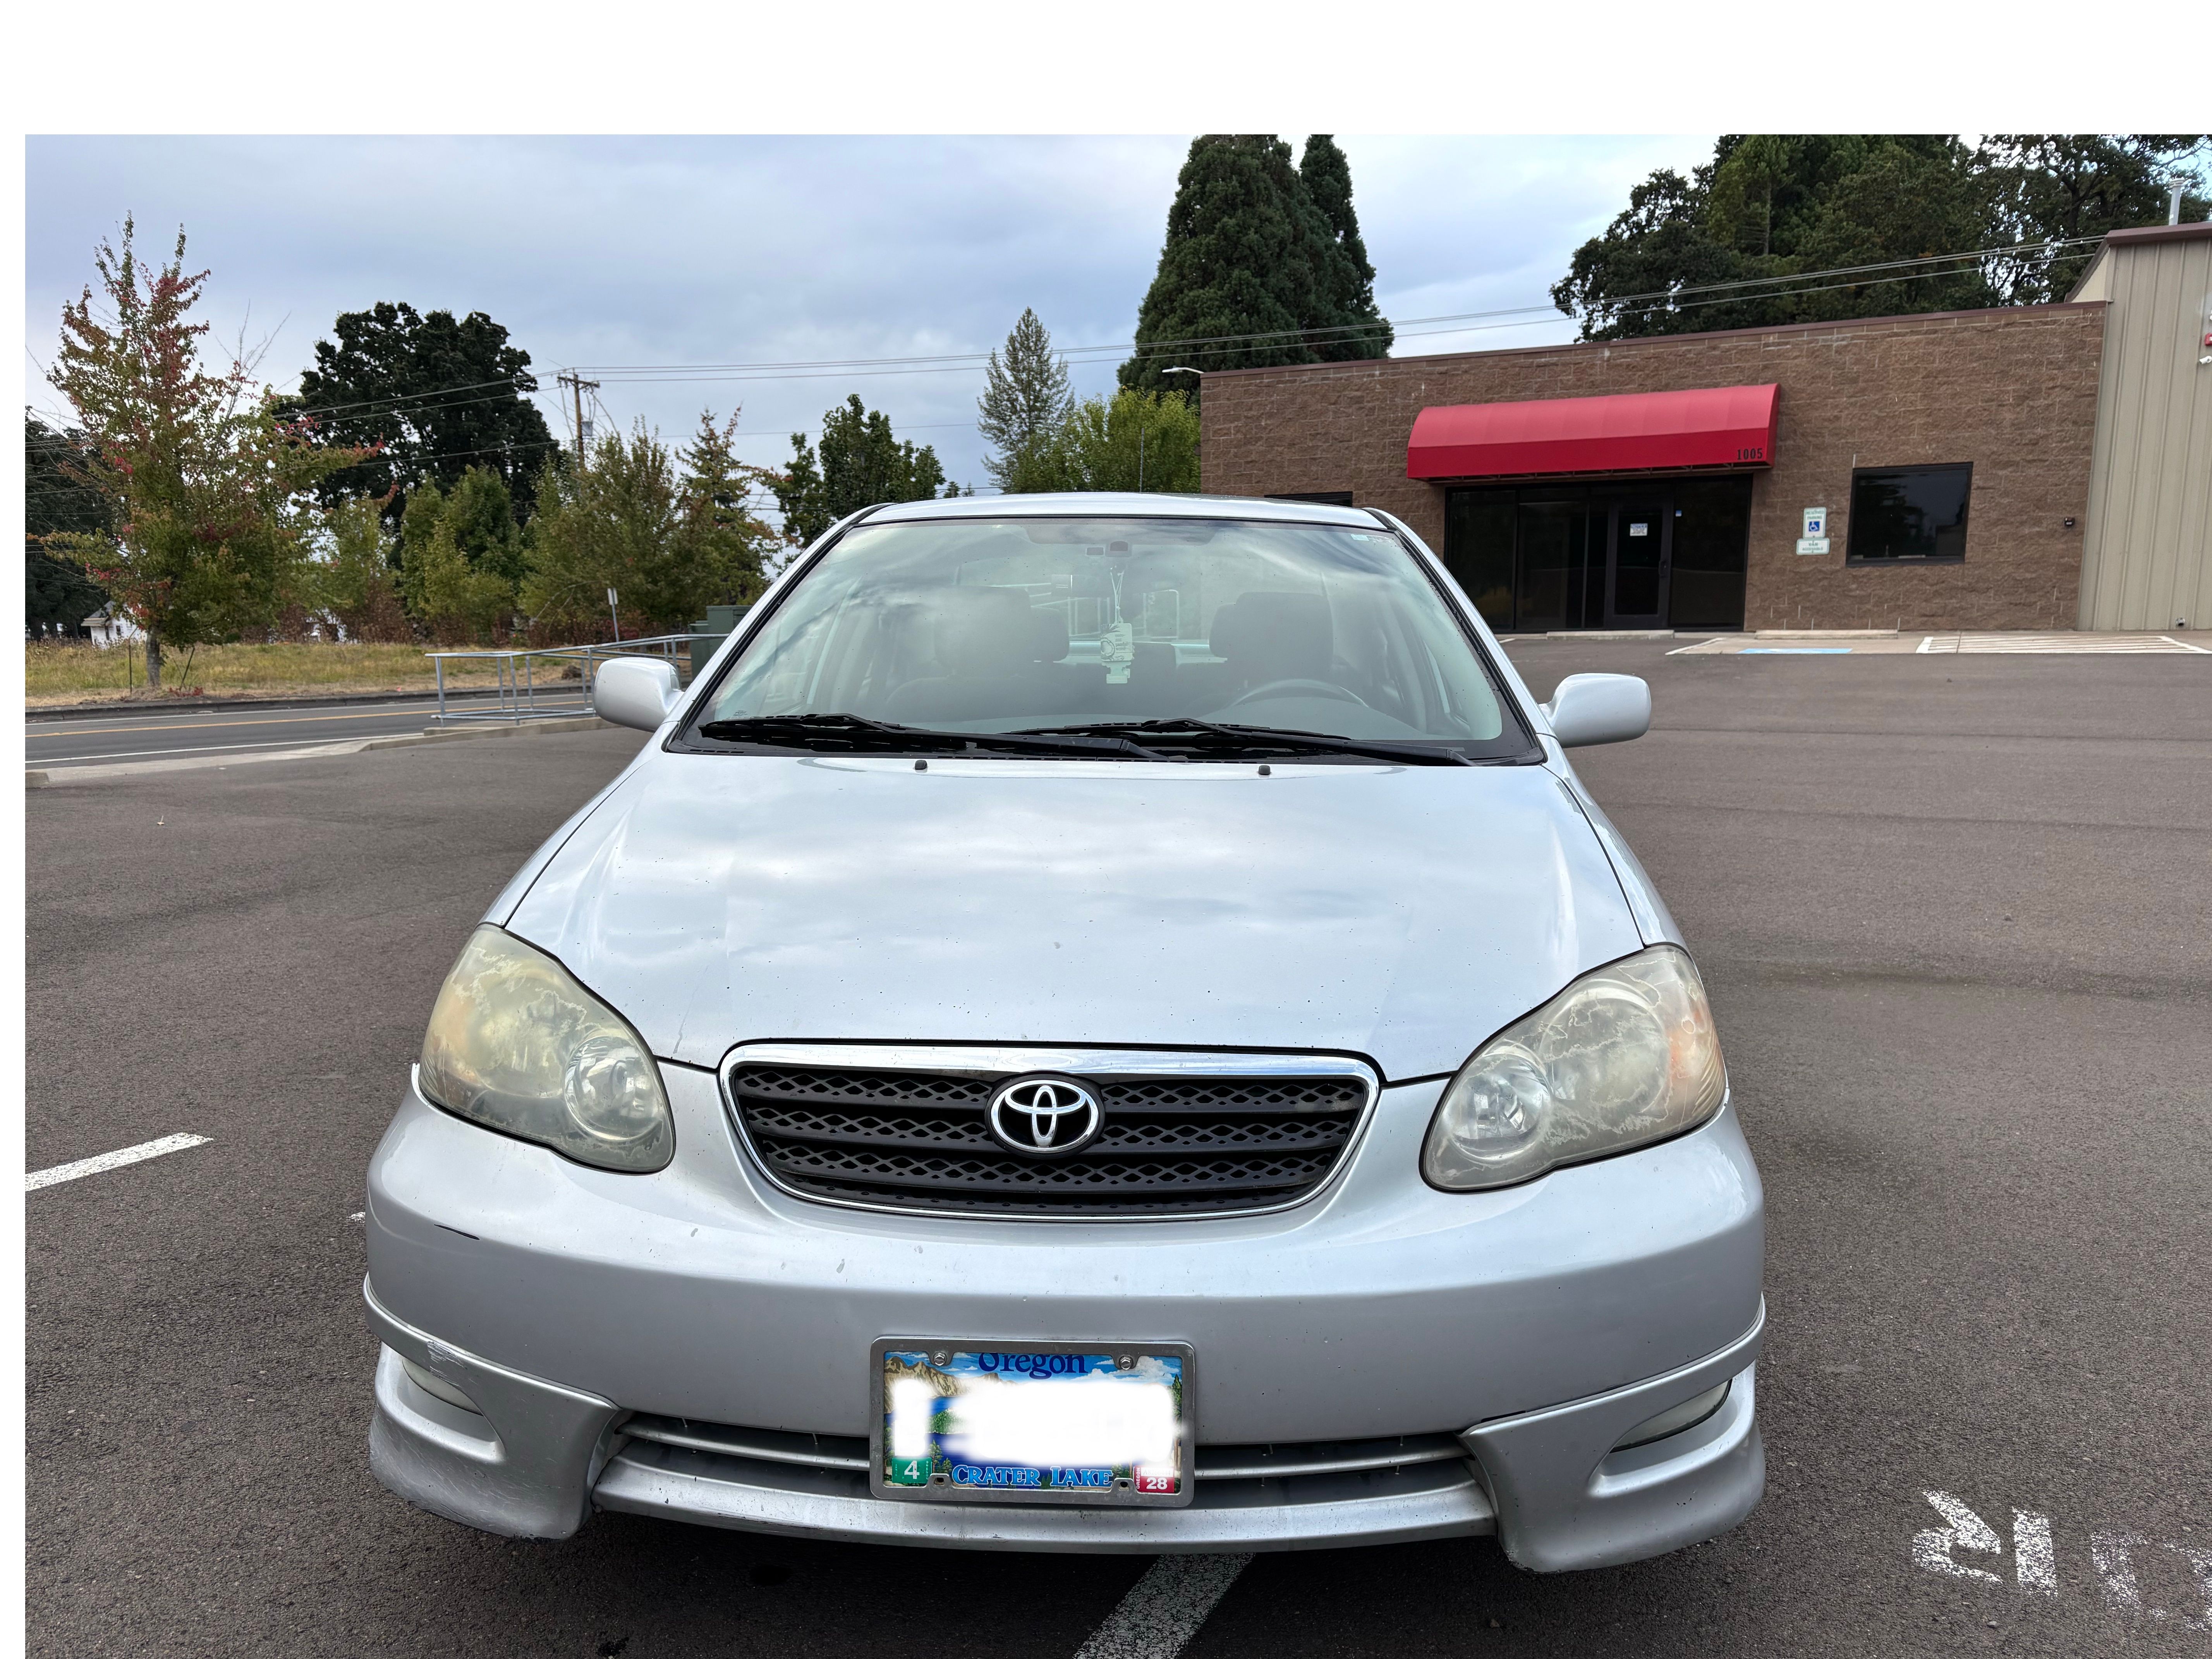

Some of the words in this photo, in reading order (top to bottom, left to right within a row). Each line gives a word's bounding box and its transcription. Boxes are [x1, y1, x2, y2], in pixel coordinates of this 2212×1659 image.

[1738, 448, 1763, 460] 1005
[979, 1352, 1089, 1380] Oregon
[904, 1460, 920, 1479] 4
[952, 1464, 1041, 1486] CRATER
[1050, 1466, 1113, 1487] LAKE
[1146, 1477, 1168, 1490] 28
